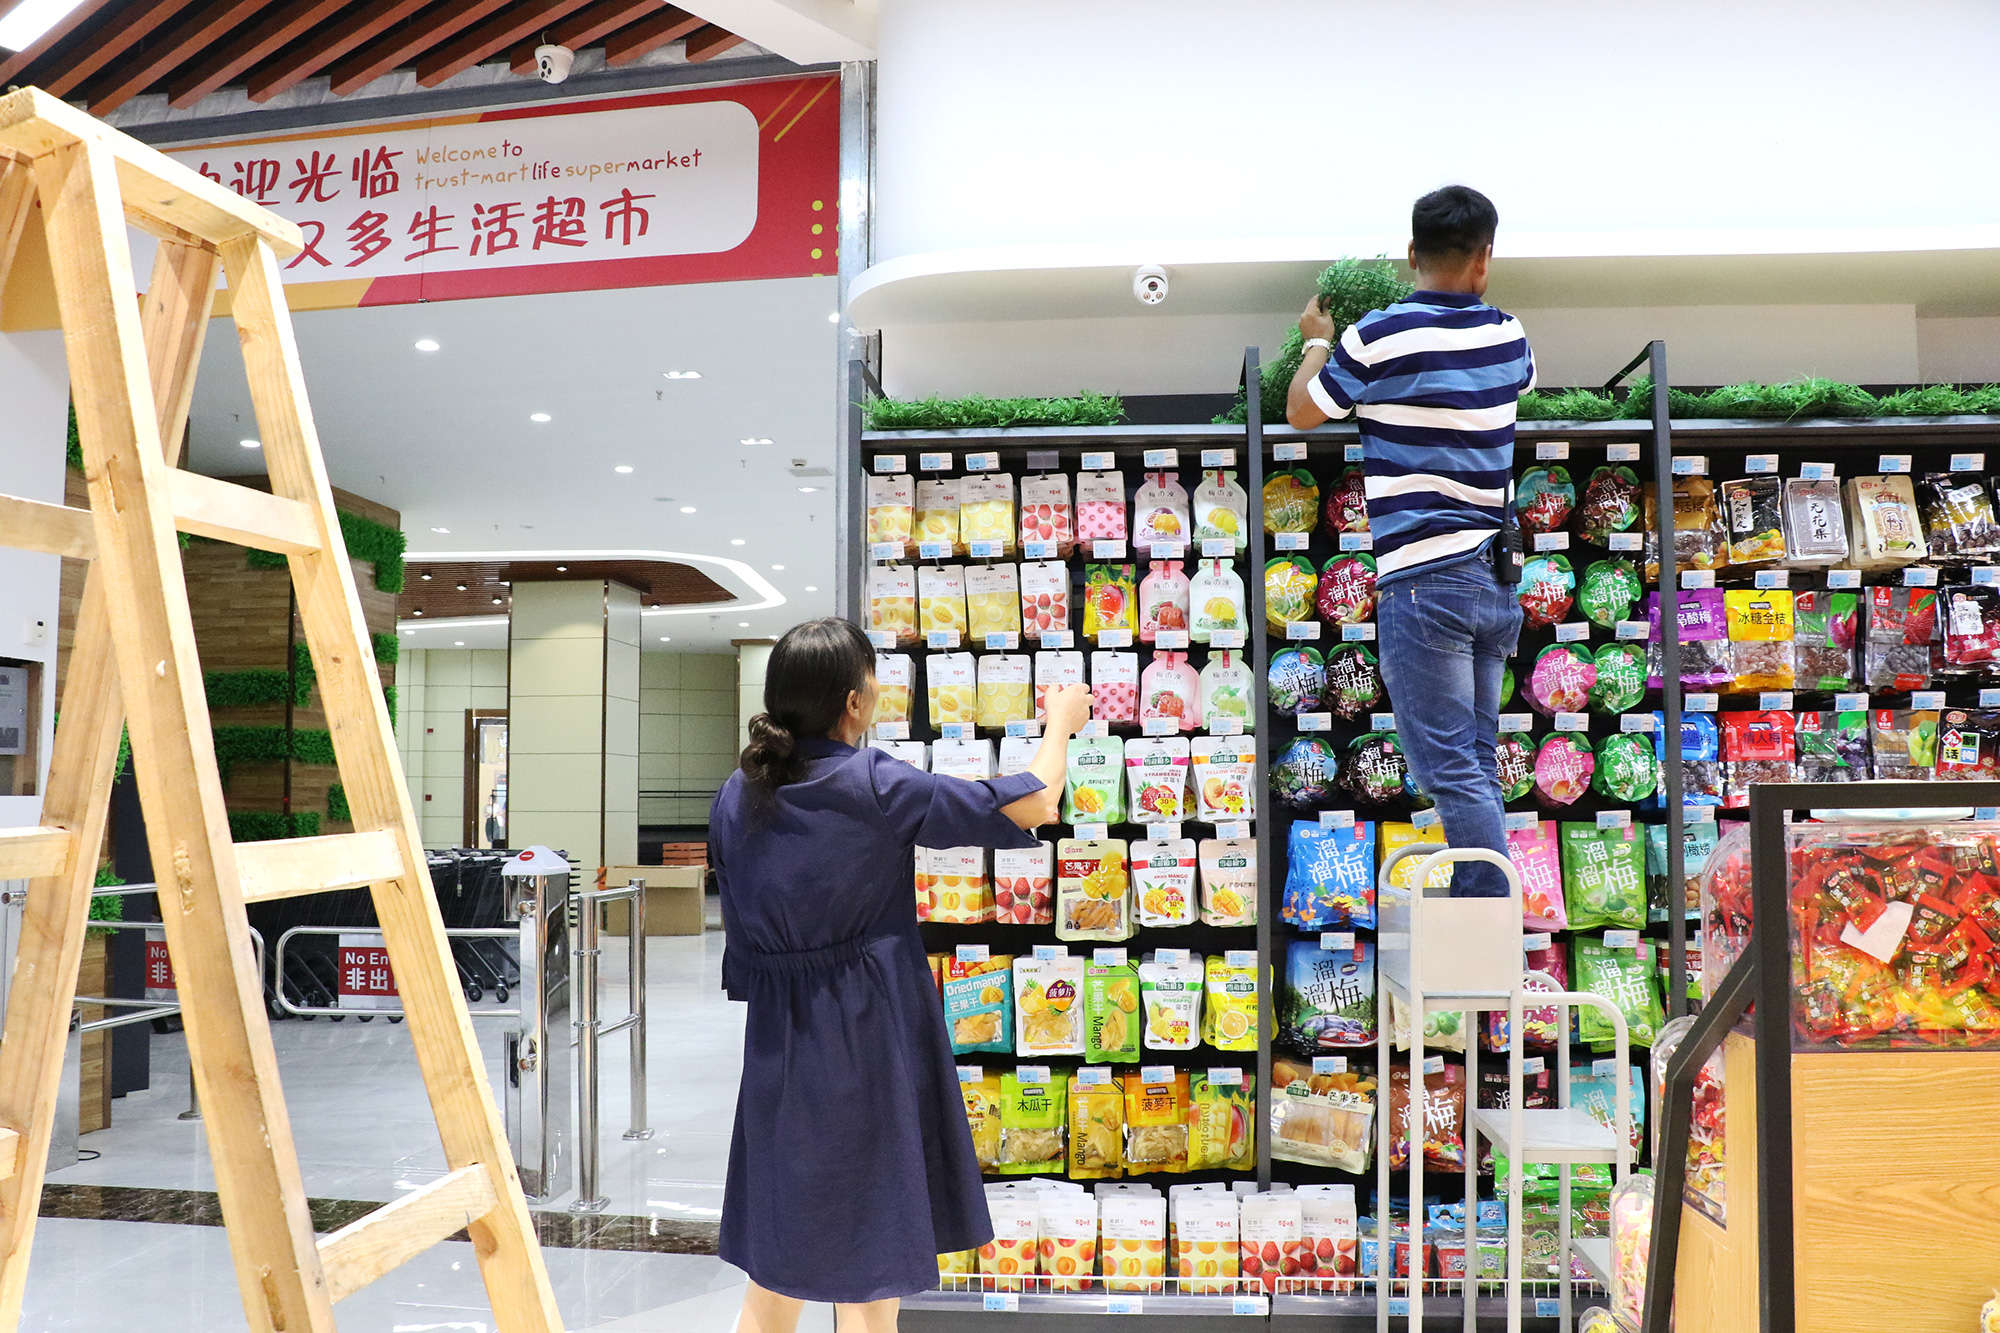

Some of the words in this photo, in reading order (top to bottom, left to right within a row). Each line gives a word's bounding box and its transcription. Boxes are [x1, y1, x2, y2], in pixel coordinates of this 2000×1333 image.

[415, 146, 498, 166] Welcome
[501, 140, 523, 159] to
[414, 163, 528, 190] trust-mart
[531, 160, 561, 181] life
[564, 148, 703, 181] supermarket
[1327, 566, 1369, 606] 溜溜梅
[1738, 612, 1786, 625] 冰糖金桔
[1743, 731, 1781, 745] 情人梅
[1308, 838, 1368, 889] 溜溜梅
[1575, 840, 1640, 895] 溜溜梅
[150, 946, 168, 959] No
[345, 952, 366, 965] No
[369, 952, 389, 965] En
[151, 961, 177, 984] 非
[346, 967, 398, 991] 非出
[1588, 958, 1651, 1011] 溜溜梅
[946, 980, 973, 996] Dried
[972, 976, 1007, 992] mango
[1048, 987, 1073, 998] 菠萝片
[1092, 980, 1104, 1015] 芒果干
[1303, 959, 1363, 1015] 溜溜梅
[949, 998, 979, 1012] 芒果干
[1091, 1016, 1104, 1049] Mango
[1017, 1099, 1052, 1112] 木瓜干
[1076, 1096, 1089, 1132] 芒果干
[1141, 1096, 1177, 1112] 菠萝干
[1076, 1132, 1088, 1166] Mango
